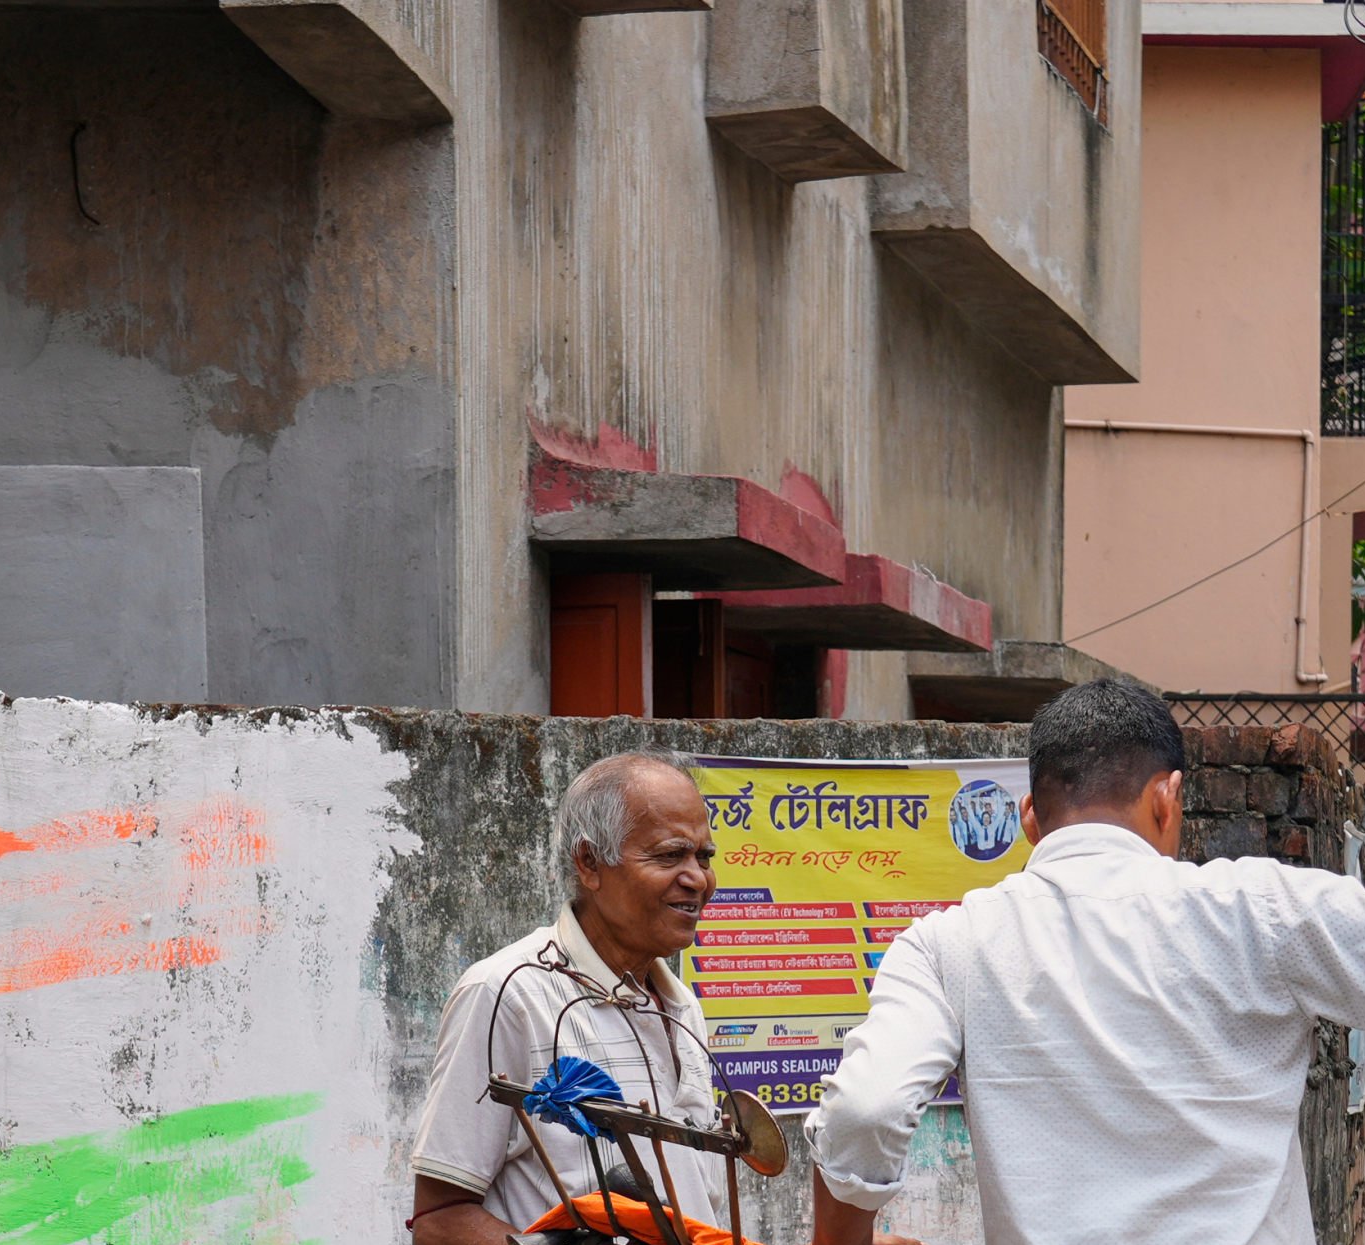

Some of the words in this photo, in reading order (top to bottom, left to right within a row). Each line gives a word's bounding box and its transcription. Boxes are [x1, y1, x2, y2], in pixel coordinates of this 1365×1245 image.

[769, 780, 930, 831] টেলিগ্রাফ
[723, 843, 797, 867] জীবন
[801, 850, 853, 874] গড়ে
[857, 850, 902, 873] দেয়
[793, 907, 824, 918] Technology
[773, 1024, 788, 1036] 0%
[709, 1037, 745, 1046] LEARN
[768, 1037, 801, 1046] Education
[802, 1036, 819, 1045] Loan
[726, 1060, 778, 1076] CAMPUS
[782, 1058, 837, 1074] SEALDAH
